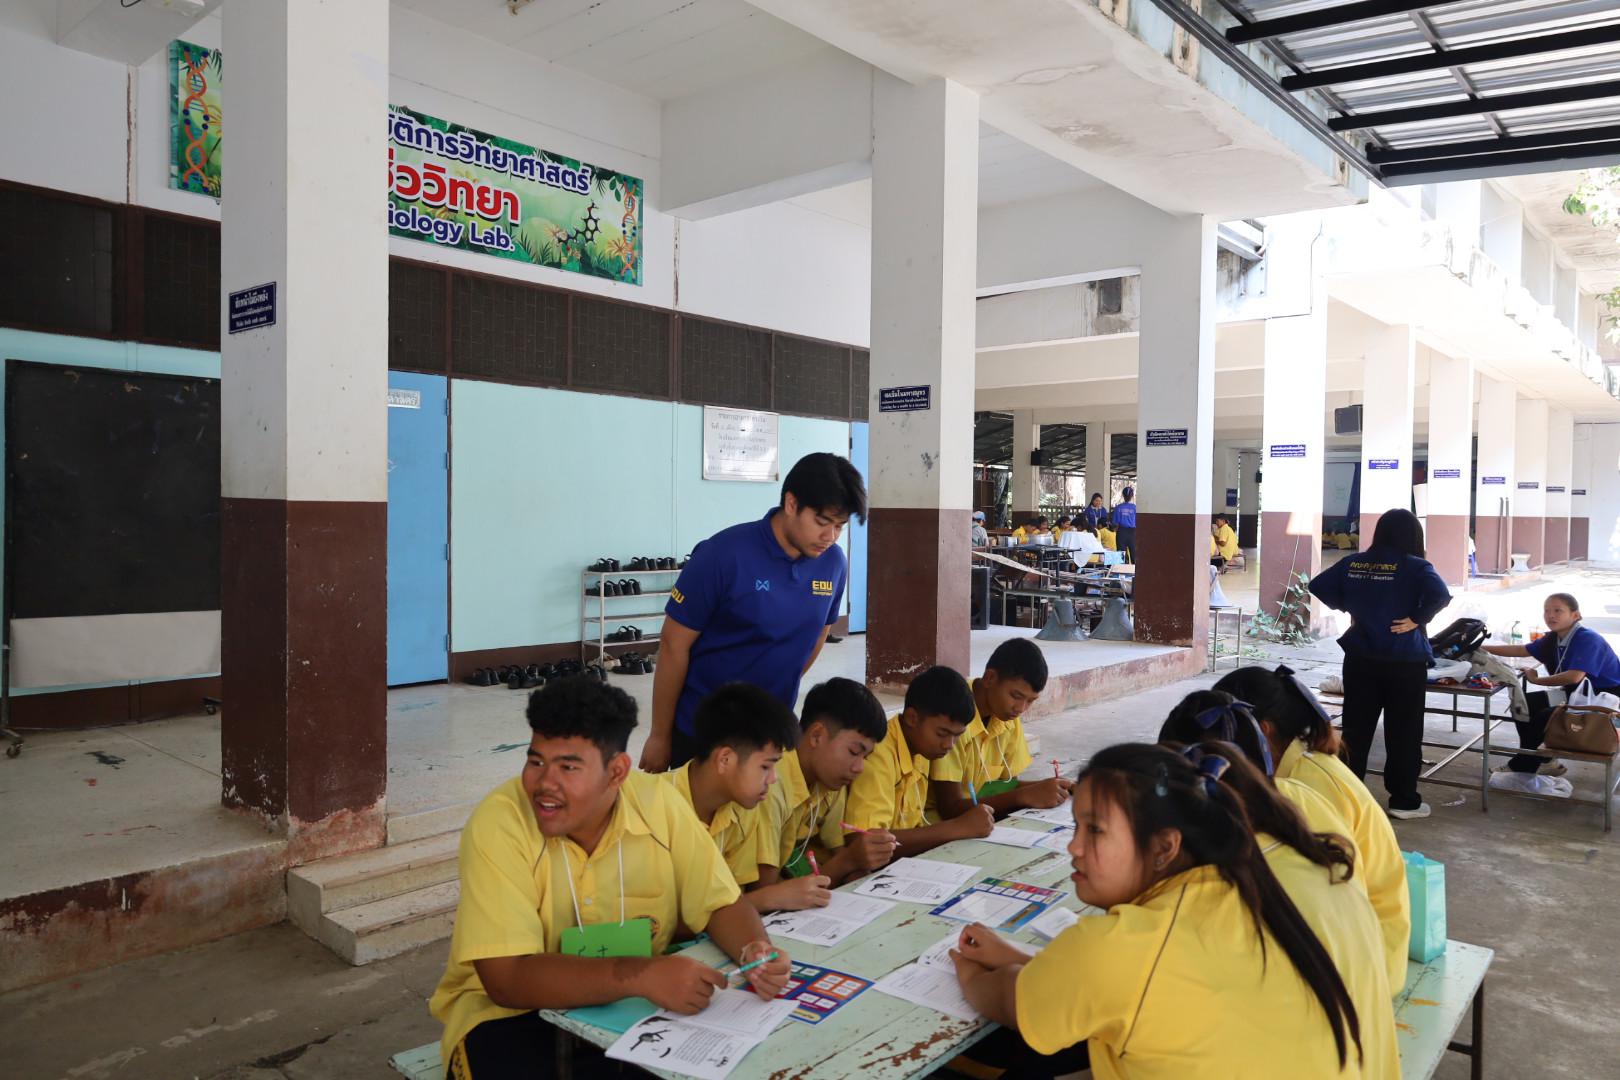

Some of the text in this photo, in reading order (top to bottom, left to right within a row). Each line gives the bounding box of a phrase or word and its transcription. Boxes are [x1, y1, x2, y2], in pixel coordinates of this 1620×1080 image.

[388, 202, 515, 250] iology Lab.
[812, 580, 832, 591] EDU
